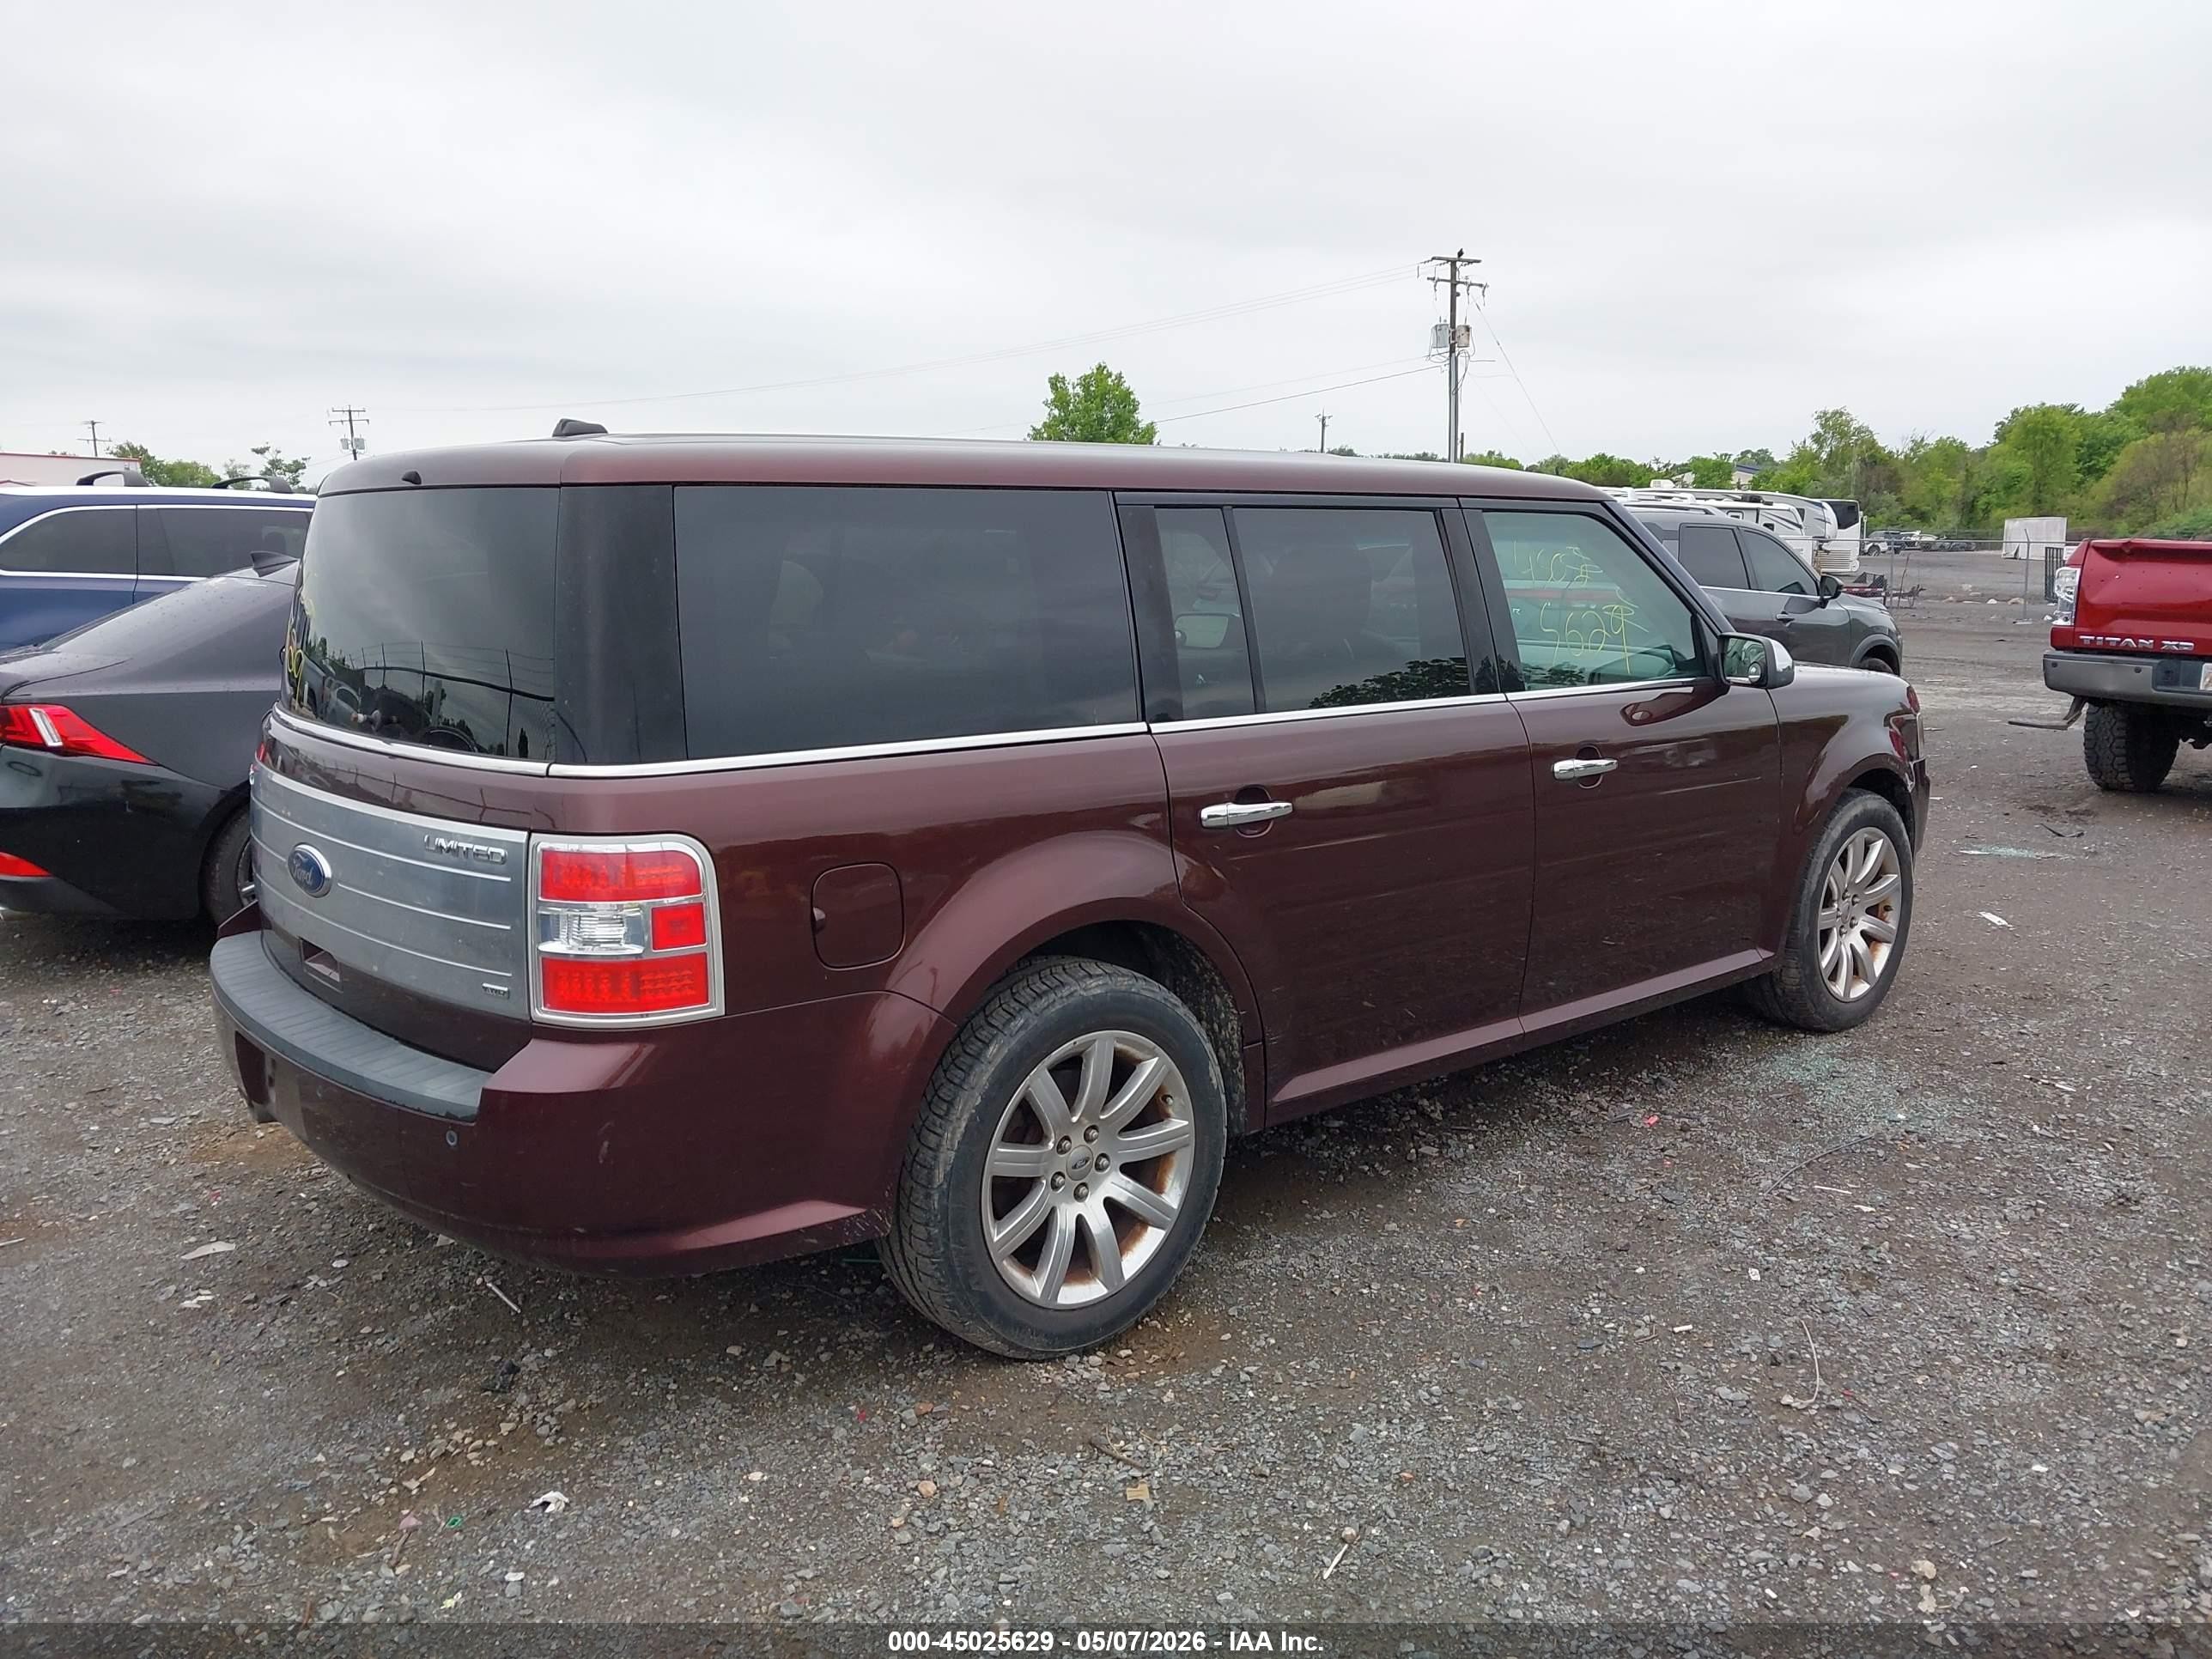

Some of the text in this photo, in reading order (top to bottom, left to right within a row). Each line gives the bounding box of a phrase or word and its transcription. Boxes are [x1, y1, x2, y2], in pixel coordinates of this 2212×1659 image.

[2079, 635, 2195, 651] TITAN XD
[424, 834, 507, 864] LIMITED
